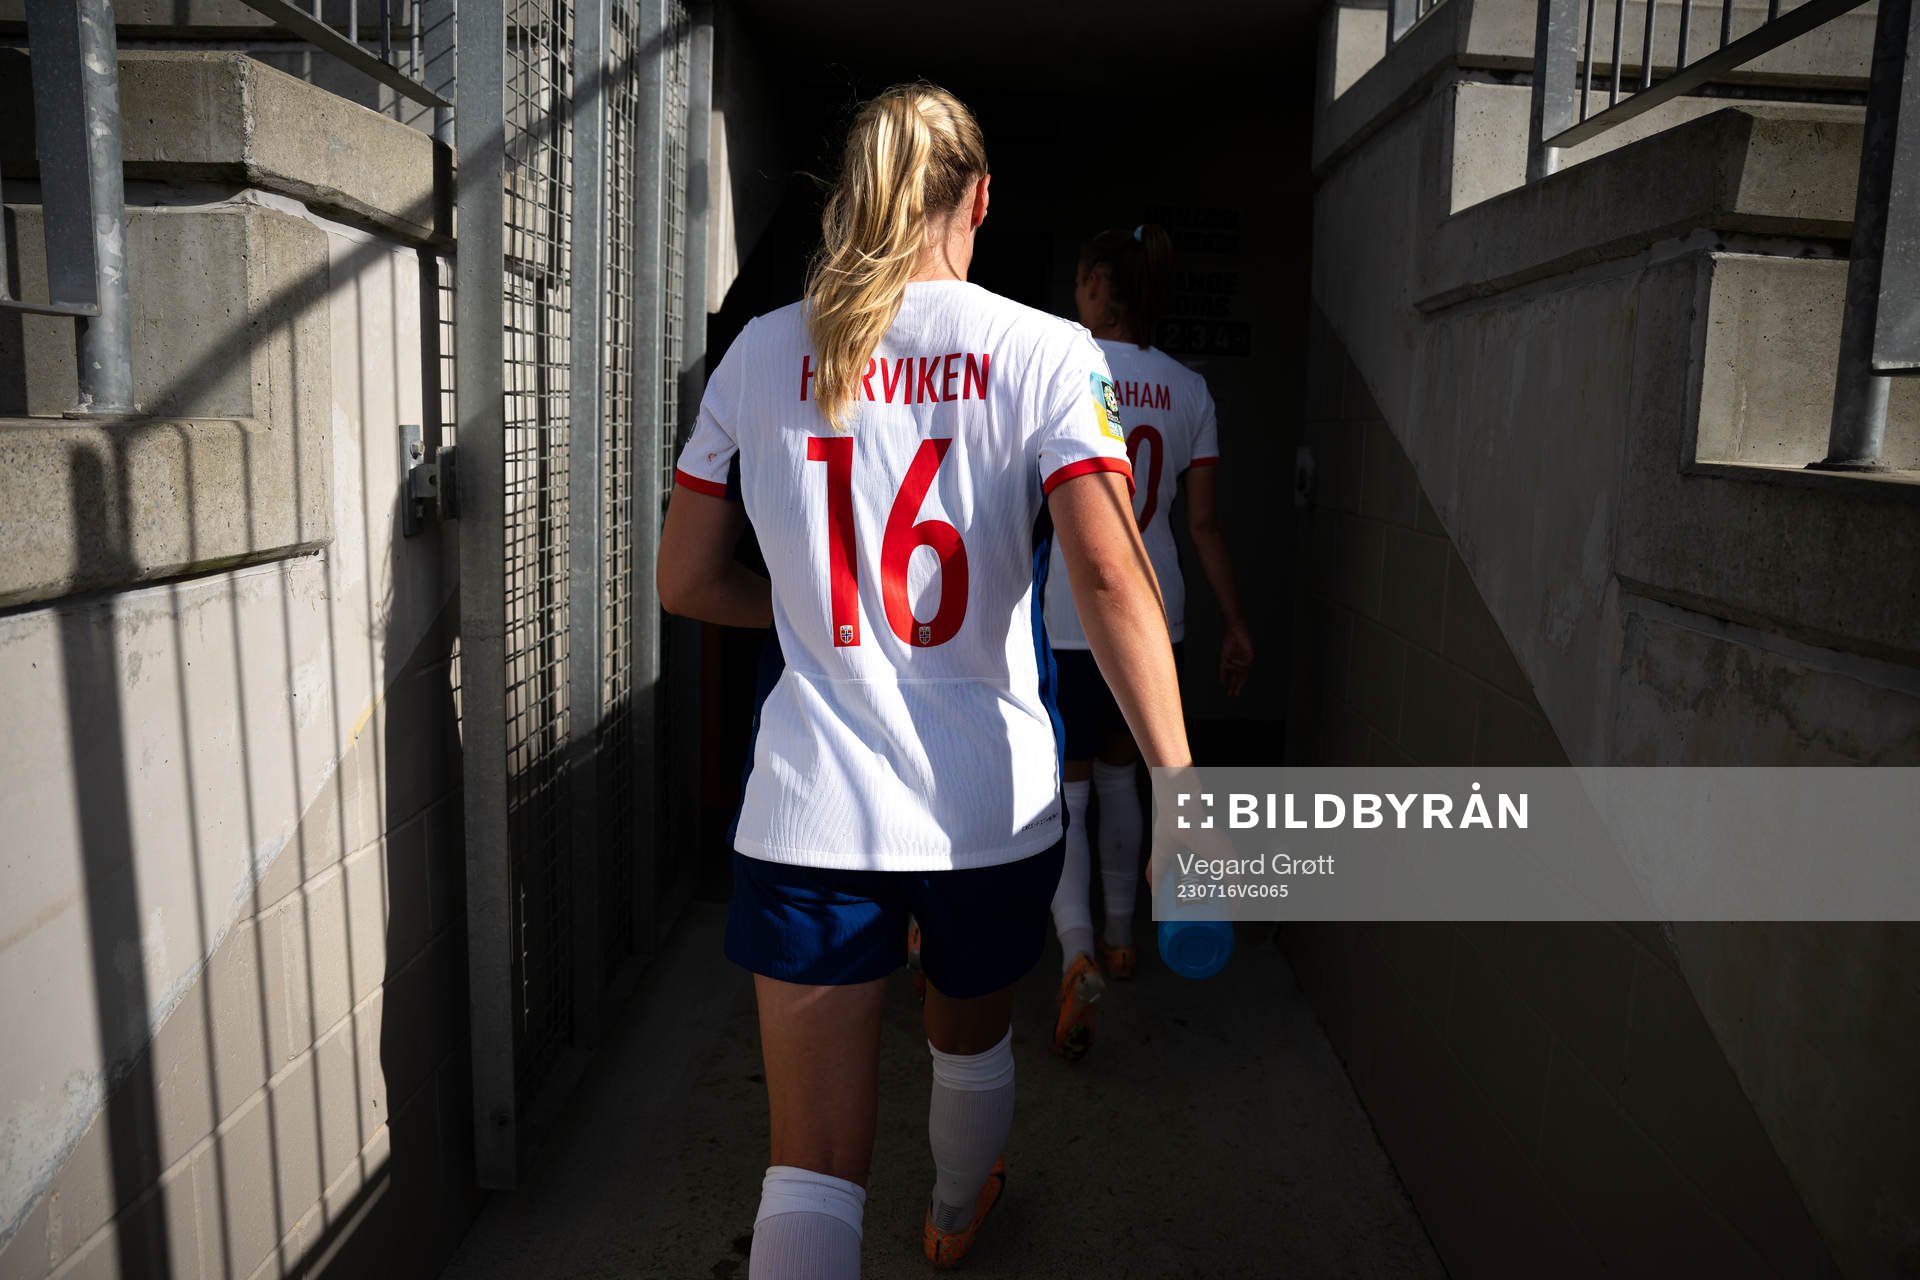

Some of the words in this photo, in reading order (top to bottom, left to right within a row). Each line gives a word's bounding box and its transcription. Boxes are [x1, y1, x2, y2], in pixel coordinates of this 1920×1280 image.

[800, 352, 990, 405] HRVIKEN
[1113, 380, 1171, 411] AHAM
[806, 436, 969, 648] 16
